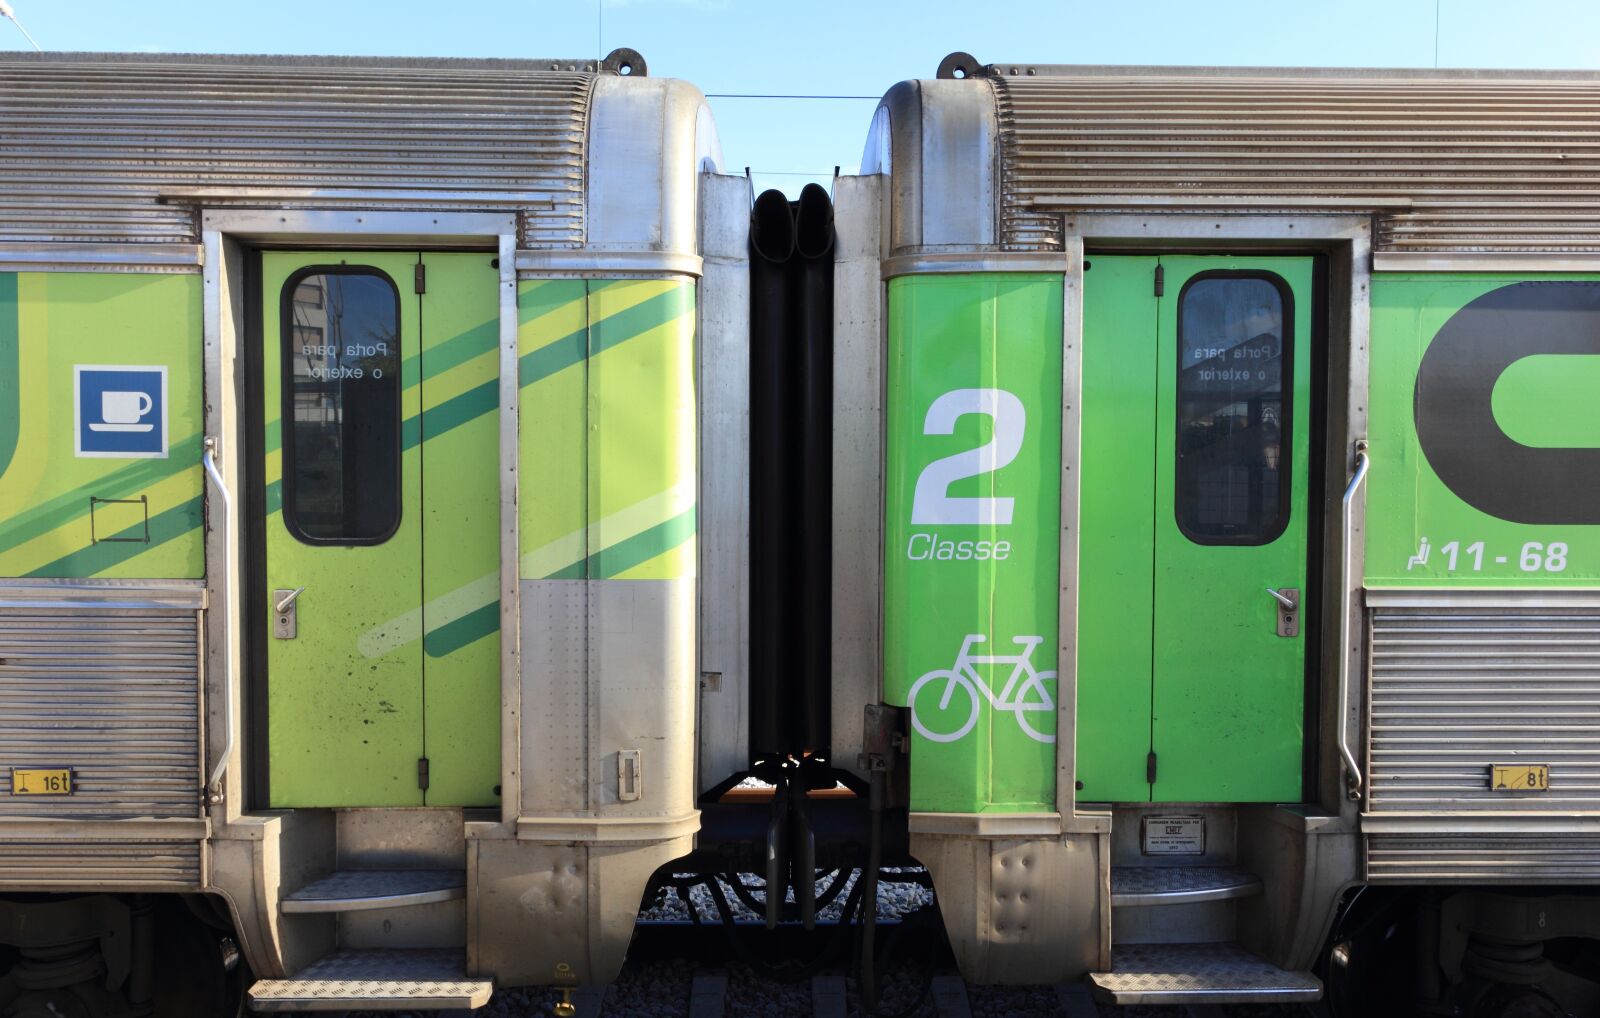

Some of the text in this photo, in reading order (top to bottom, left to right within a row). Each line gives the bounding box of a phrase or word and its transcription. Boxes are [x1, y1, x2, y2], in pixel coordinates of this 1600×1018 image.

[911, 388, 1026, 525] 2
[907, 533, 1011, 561] Classe
[1440, 541, 1485, 571] 11
[1519, 541, 1569, 572] 68
